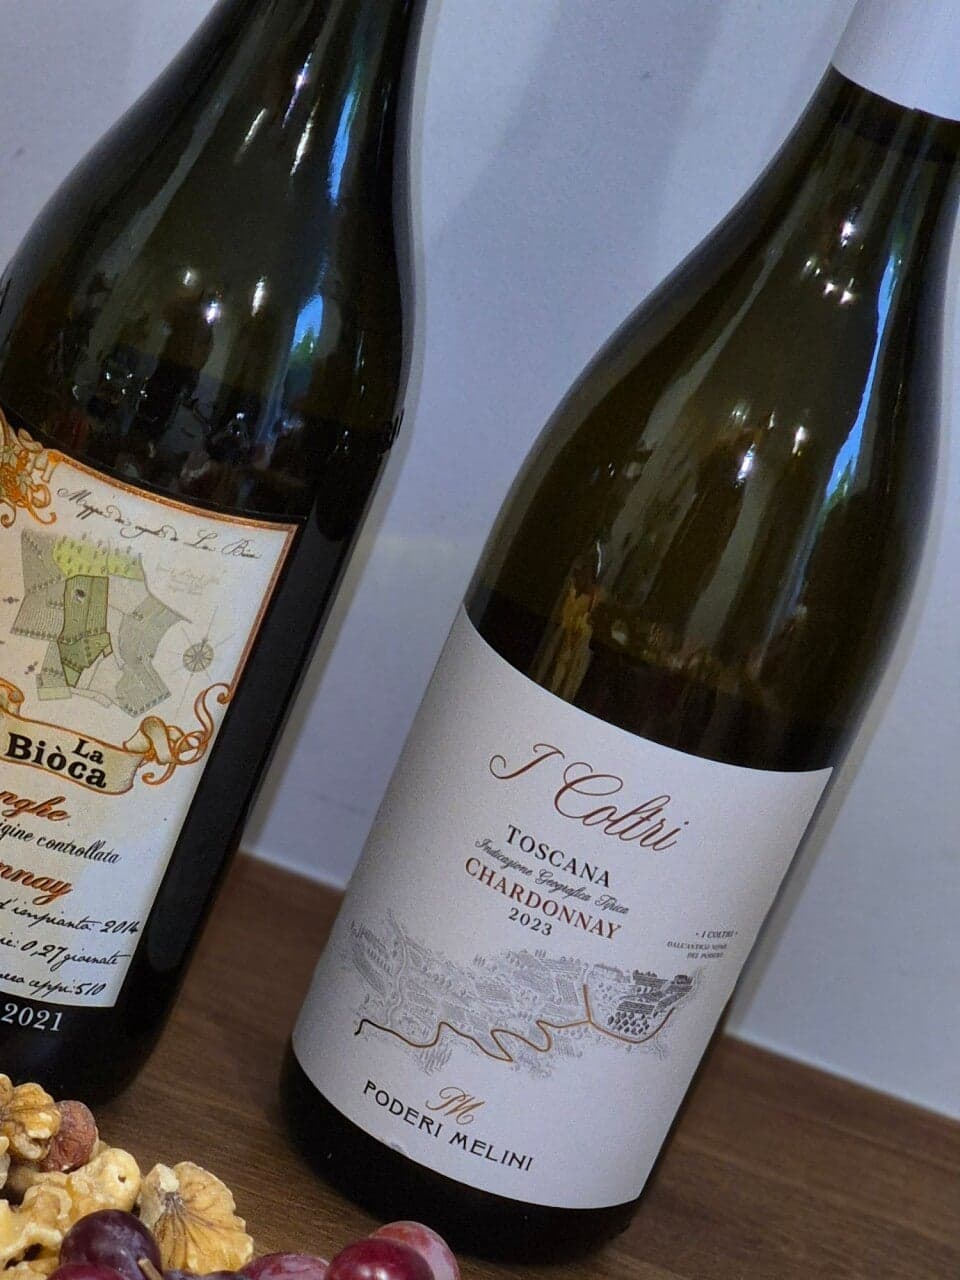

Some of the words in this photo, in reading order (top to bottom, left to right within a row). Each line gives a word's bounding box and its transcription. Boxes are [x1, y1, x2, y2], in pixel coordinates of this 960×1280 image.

[6, 731, 107, 788] Biòca
[73, 738, 104, 764] La
[554, 762, 689, 851] Coltri
[36, 834, 122, 864] controllata
[507, 824, 611, 888] TOSCANA
[475, 838, 534, 881] Indicazione
[534, 868, 592, 905] Geografica
[594, 893, 630, 915] Tipica
[465, 857, 622, 940] CHARDONNAY
[100, 920, 142, 935] 2014
[507, 906, 553, 937] 2023
[21, 940, 66, 968] 0,27
[74, 982, 107, 997] 510
[0, 1003, 65, 1032] 2021
[363, 1080, 442, 1138] PODERI
[449, 1131, 534, 1172] MELINI
